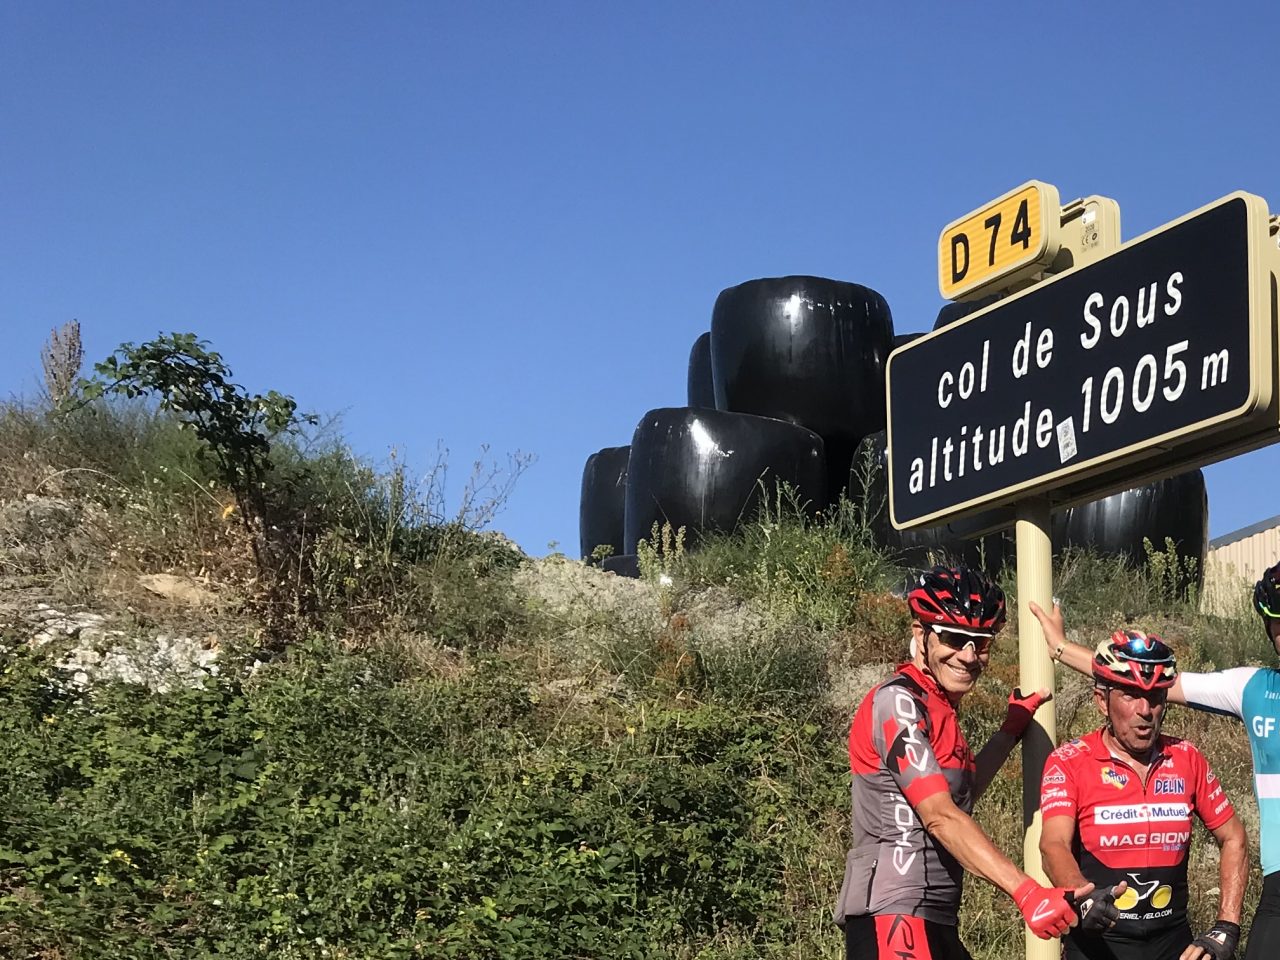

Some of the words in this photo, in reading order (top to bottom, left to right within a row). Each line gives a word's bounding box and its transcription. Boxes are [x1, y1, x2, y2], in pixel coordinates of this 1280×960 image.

[951, 231, 970, 285] D
[984, 198, 1033, 267] 74
[937, 339, 990, 409] col
[1011, 321, 1054, 380] de
[1079, 271, 1185, 350] Sous
[908, 400, 1053, 495] altitude
[1080, 339, 1190, 434] 1005
[1199, 348, 1230, 391] m
[1252, 715, 1276, 738] GF
[1100, 808, 1138, 821] Crédit
[1151, 805, 1187, 818] Mutuel
[1154, 778, 1185, 794] DELIN
